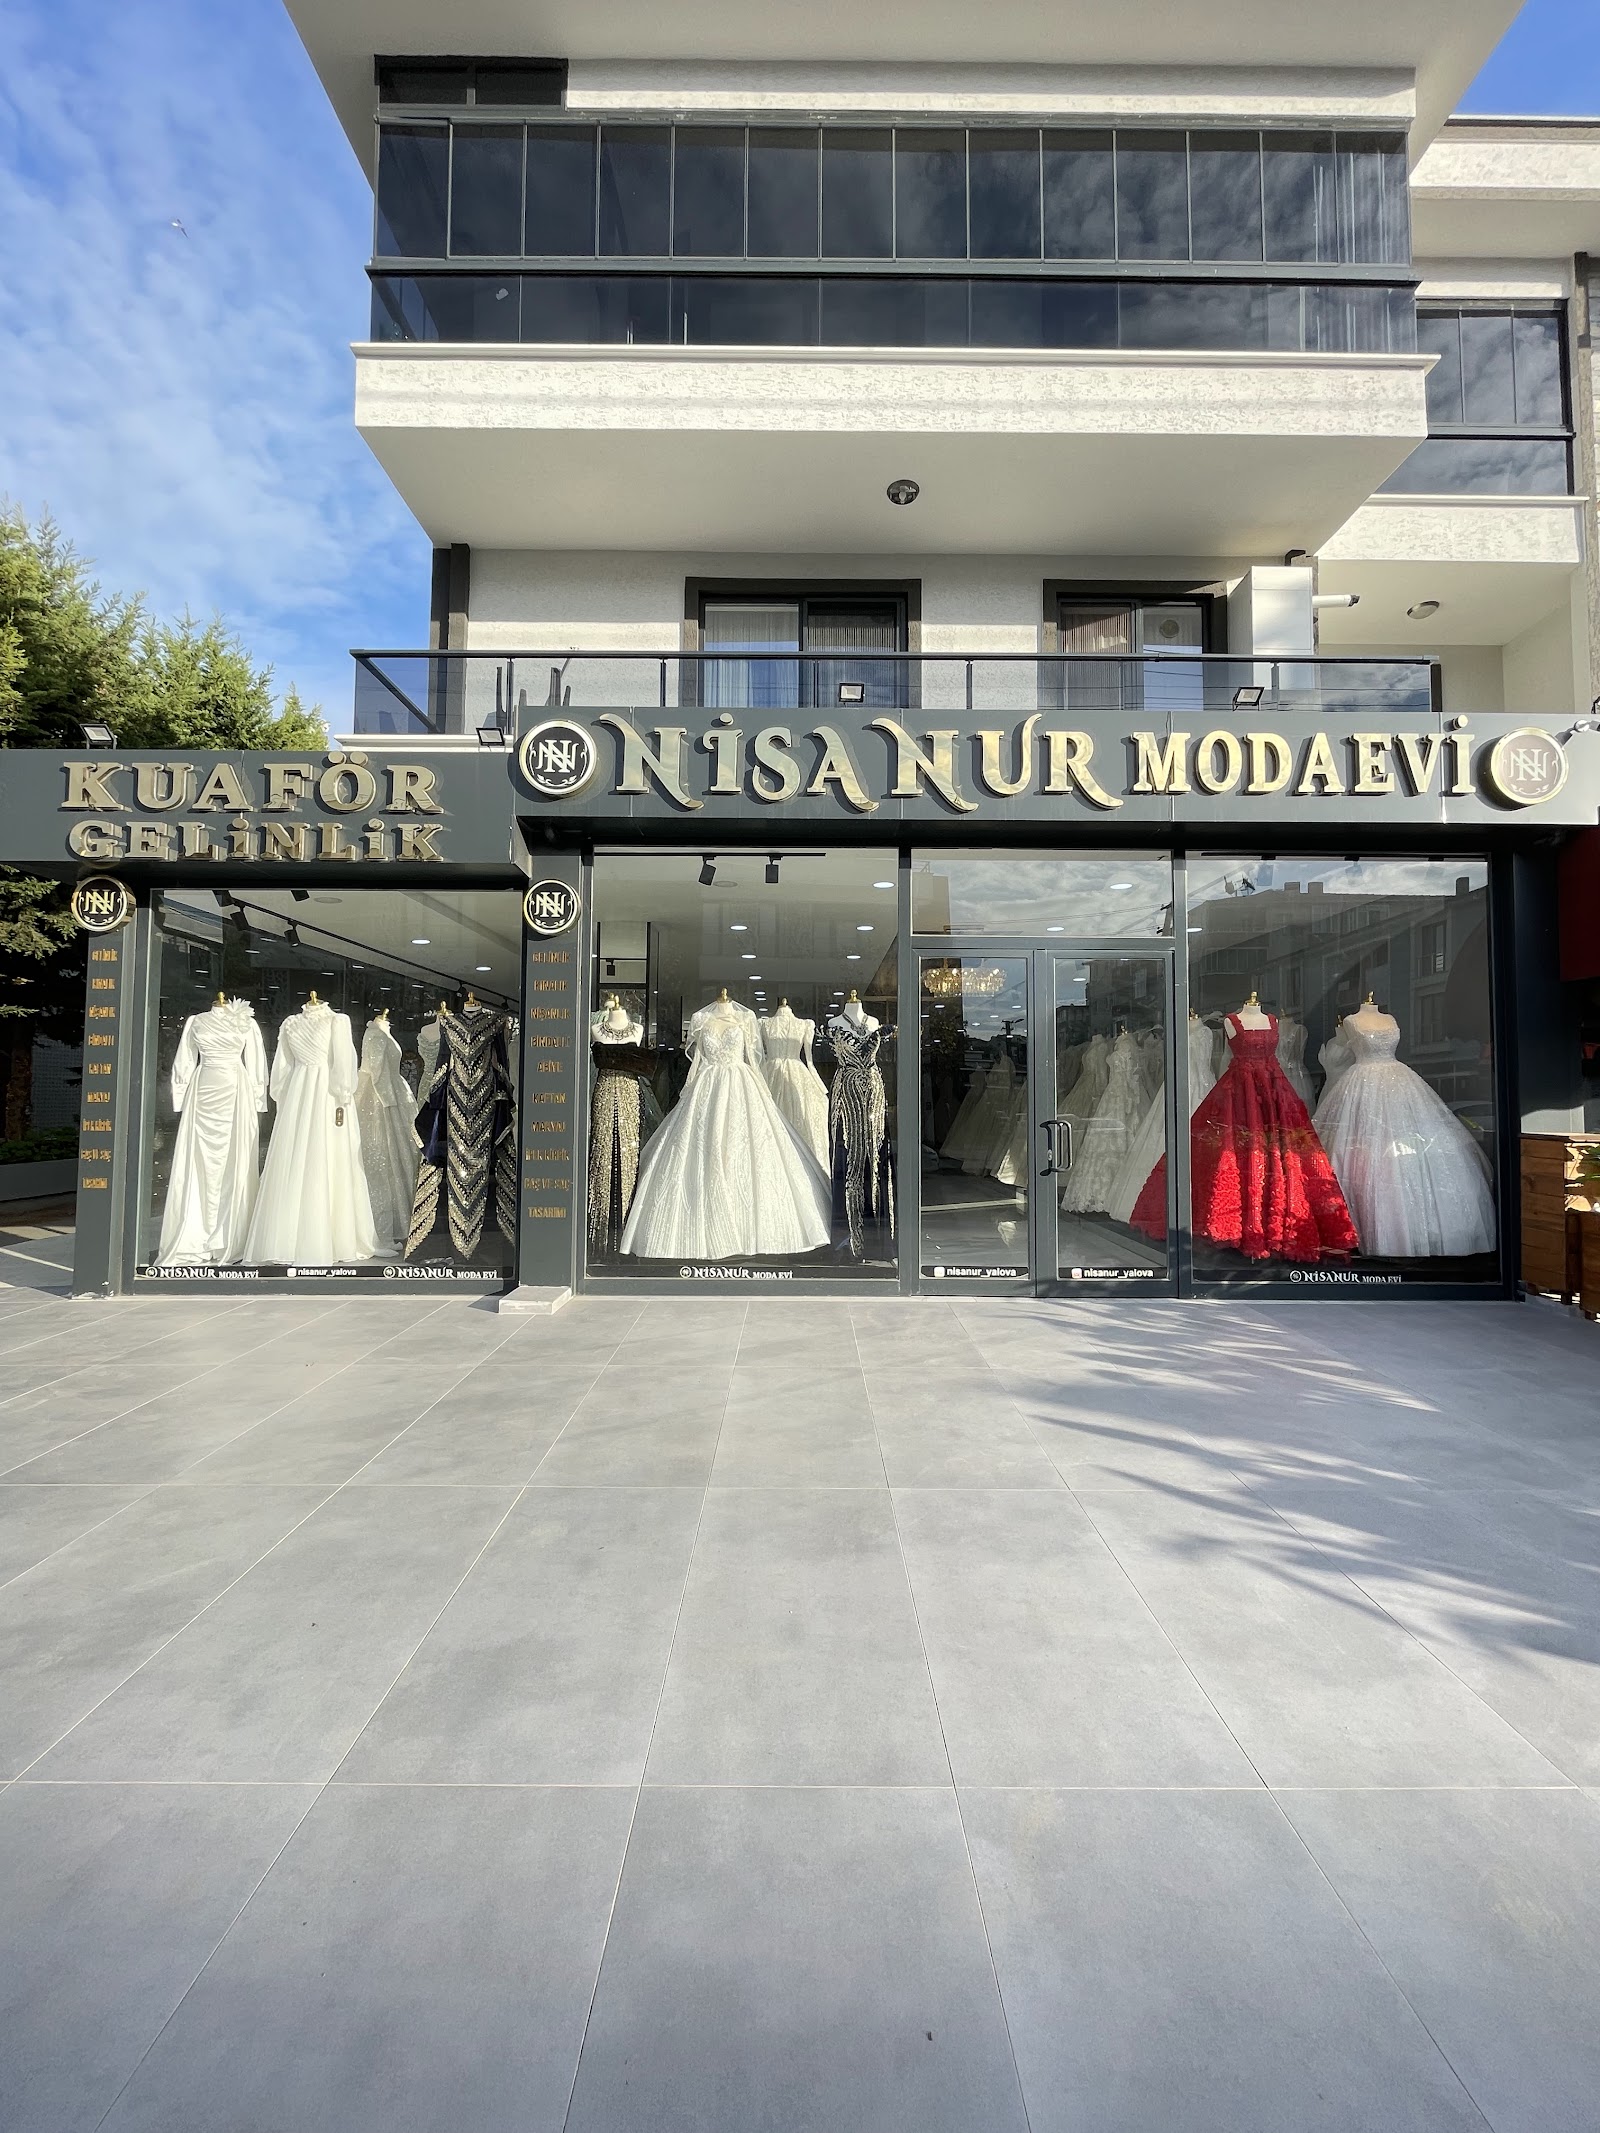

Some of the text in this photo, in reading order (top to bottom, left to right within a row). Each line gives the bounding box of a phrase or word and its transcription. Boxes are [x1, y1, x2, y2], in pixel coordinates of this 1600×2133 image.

[60, 751, 446, 814] KUAFÖR
[68, 817, 445, 863] GELİNLİK
[158, 1266, 218, 1279] NİSANUR
[218, 1271, 243, 1279] MODA
[297, 1267, 357, 1278] nisanur_yalova
[395, 1266, 457, 1279] NİSANUR
[456, 1271, 481, 1279] MODA
[692, 1266, 752, 1279] NİSANUR
[752, 1271, 778, 1279] MODA
[946, 1266, 1017, 1278] nisanur_yalova
[1083, 1267, 1154, 1279] nisanur_yalova
[1301, 1270, 1361, 1283] NİSANUR
